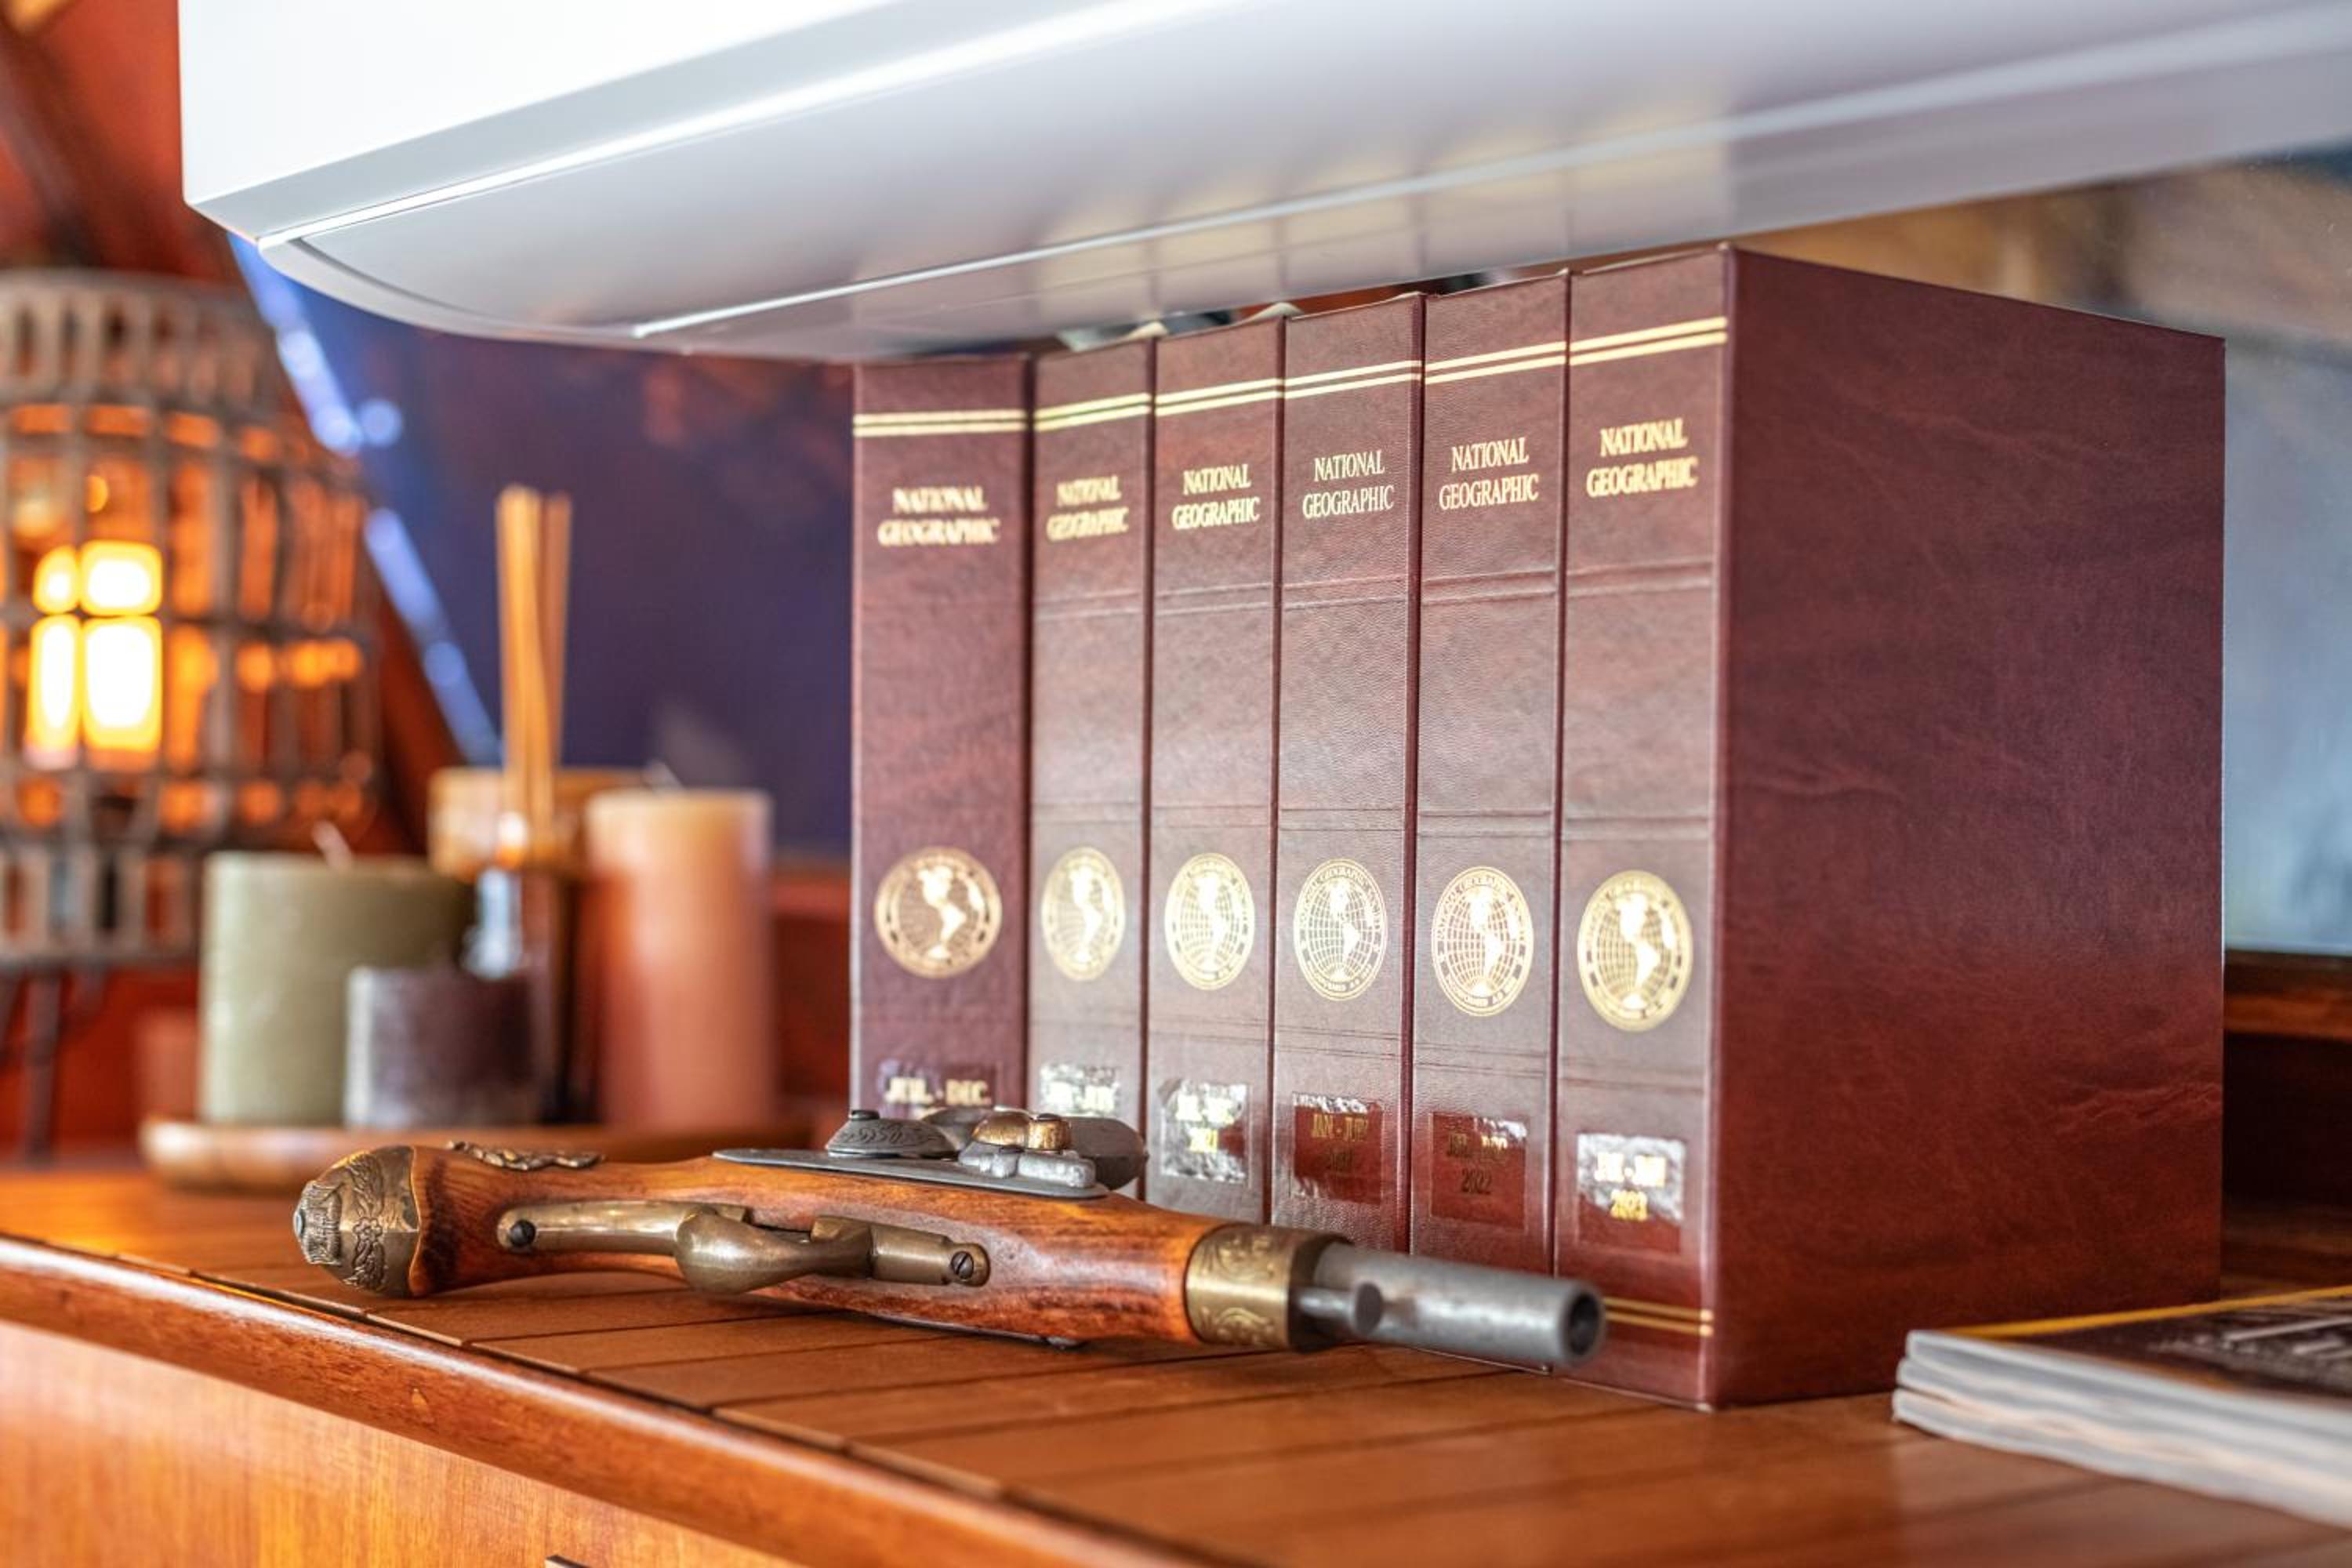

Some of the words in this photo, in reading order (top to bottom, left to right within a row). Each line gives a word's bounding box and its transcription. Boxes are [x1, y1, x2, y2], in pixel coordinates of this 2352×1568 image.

[1451, 437, 1530, 473] NATIONAL
[1599, 418, 1688, 457] NATIONAL
[1183, 463, 1251, 495] NATIONAL
[1314, 449, 1385, 482] NATIONAL
[1586, 456, 1698, 498] GEOGRAPHIC
[892, 487, 988, 514] NATIONAL
[1057, 475, 1122, 506] NATIONAL
[1302, 485, 1395, 520] GEOGRAPHIC
[1439, 474, 1539, 510] GEOGRAPHIC
[1047, 506, 1129, 541] GEOGRAPHIC
[1172, 497, 1261, 531] GEOGRAPHIC
